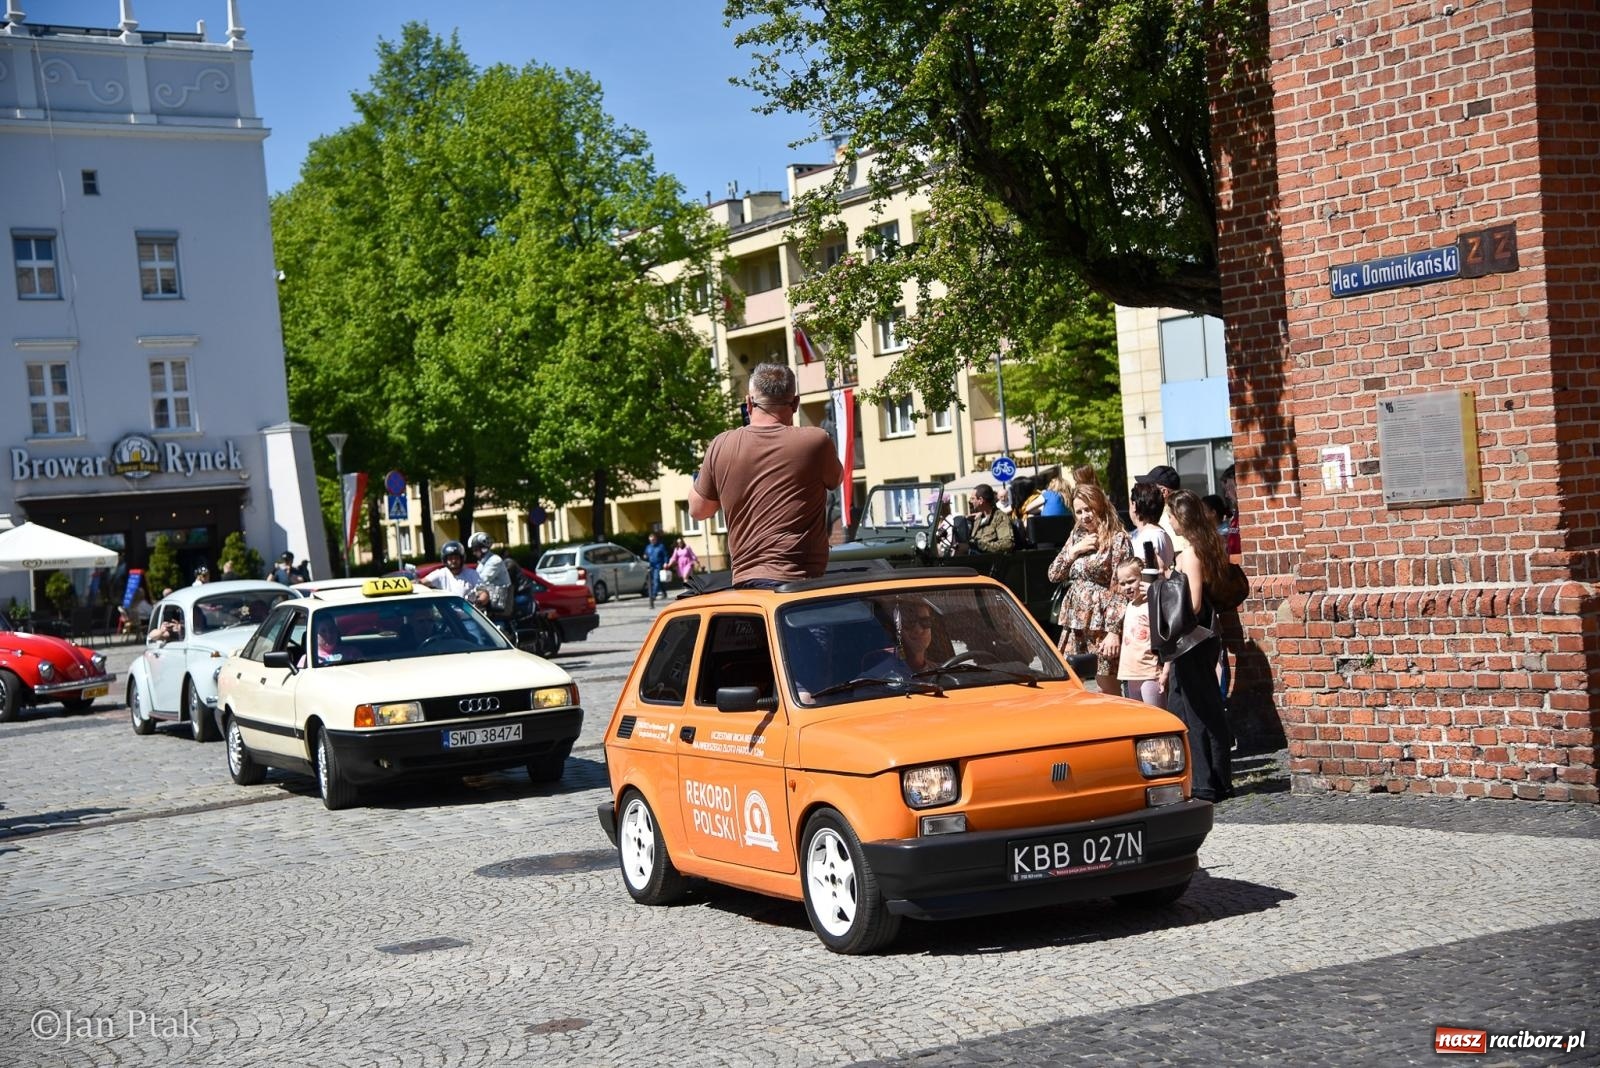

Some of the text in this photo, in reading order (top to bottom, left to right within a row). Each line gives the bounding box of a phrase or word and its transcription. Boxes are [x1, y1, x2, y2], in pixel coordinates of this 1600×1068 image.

[1331, 250, 1457, 292] Plac Dominikański
[11, 440, 243, 480] Browar Rynek
[370, 579, 408, 591] TAXI
[450, 725, 521, 746] SWD 38474
[685, 779, 732, 811] REKORD
[693, 808, 737, 840] POLSKI
[1014, 831, 1143, 873] KBB 027N
